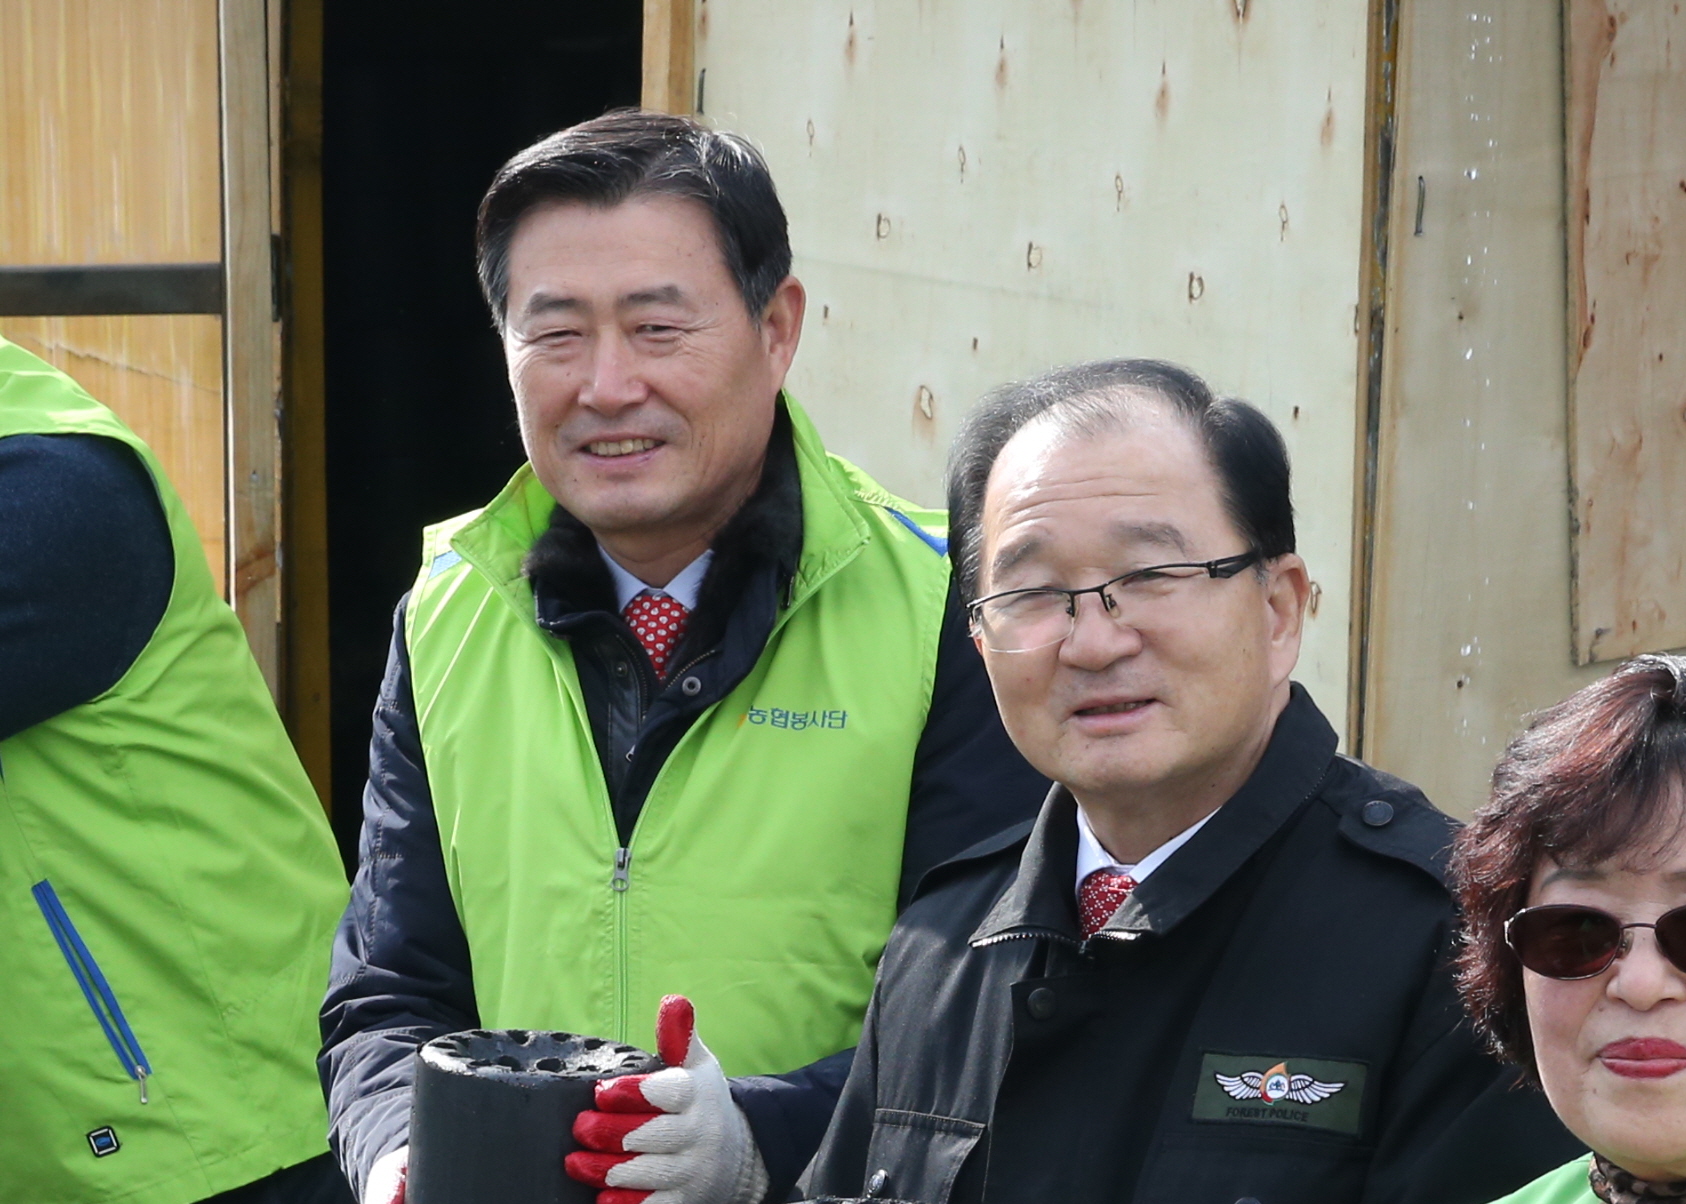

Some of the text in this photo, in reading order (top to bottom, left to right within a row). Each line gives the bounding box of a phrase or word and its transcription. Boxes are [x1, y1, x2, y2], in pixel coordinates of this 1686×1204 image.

[748, 706, 848, 731] 농협봉사단
[1226, 1107, 1309, 1122] FOREST POLICE
